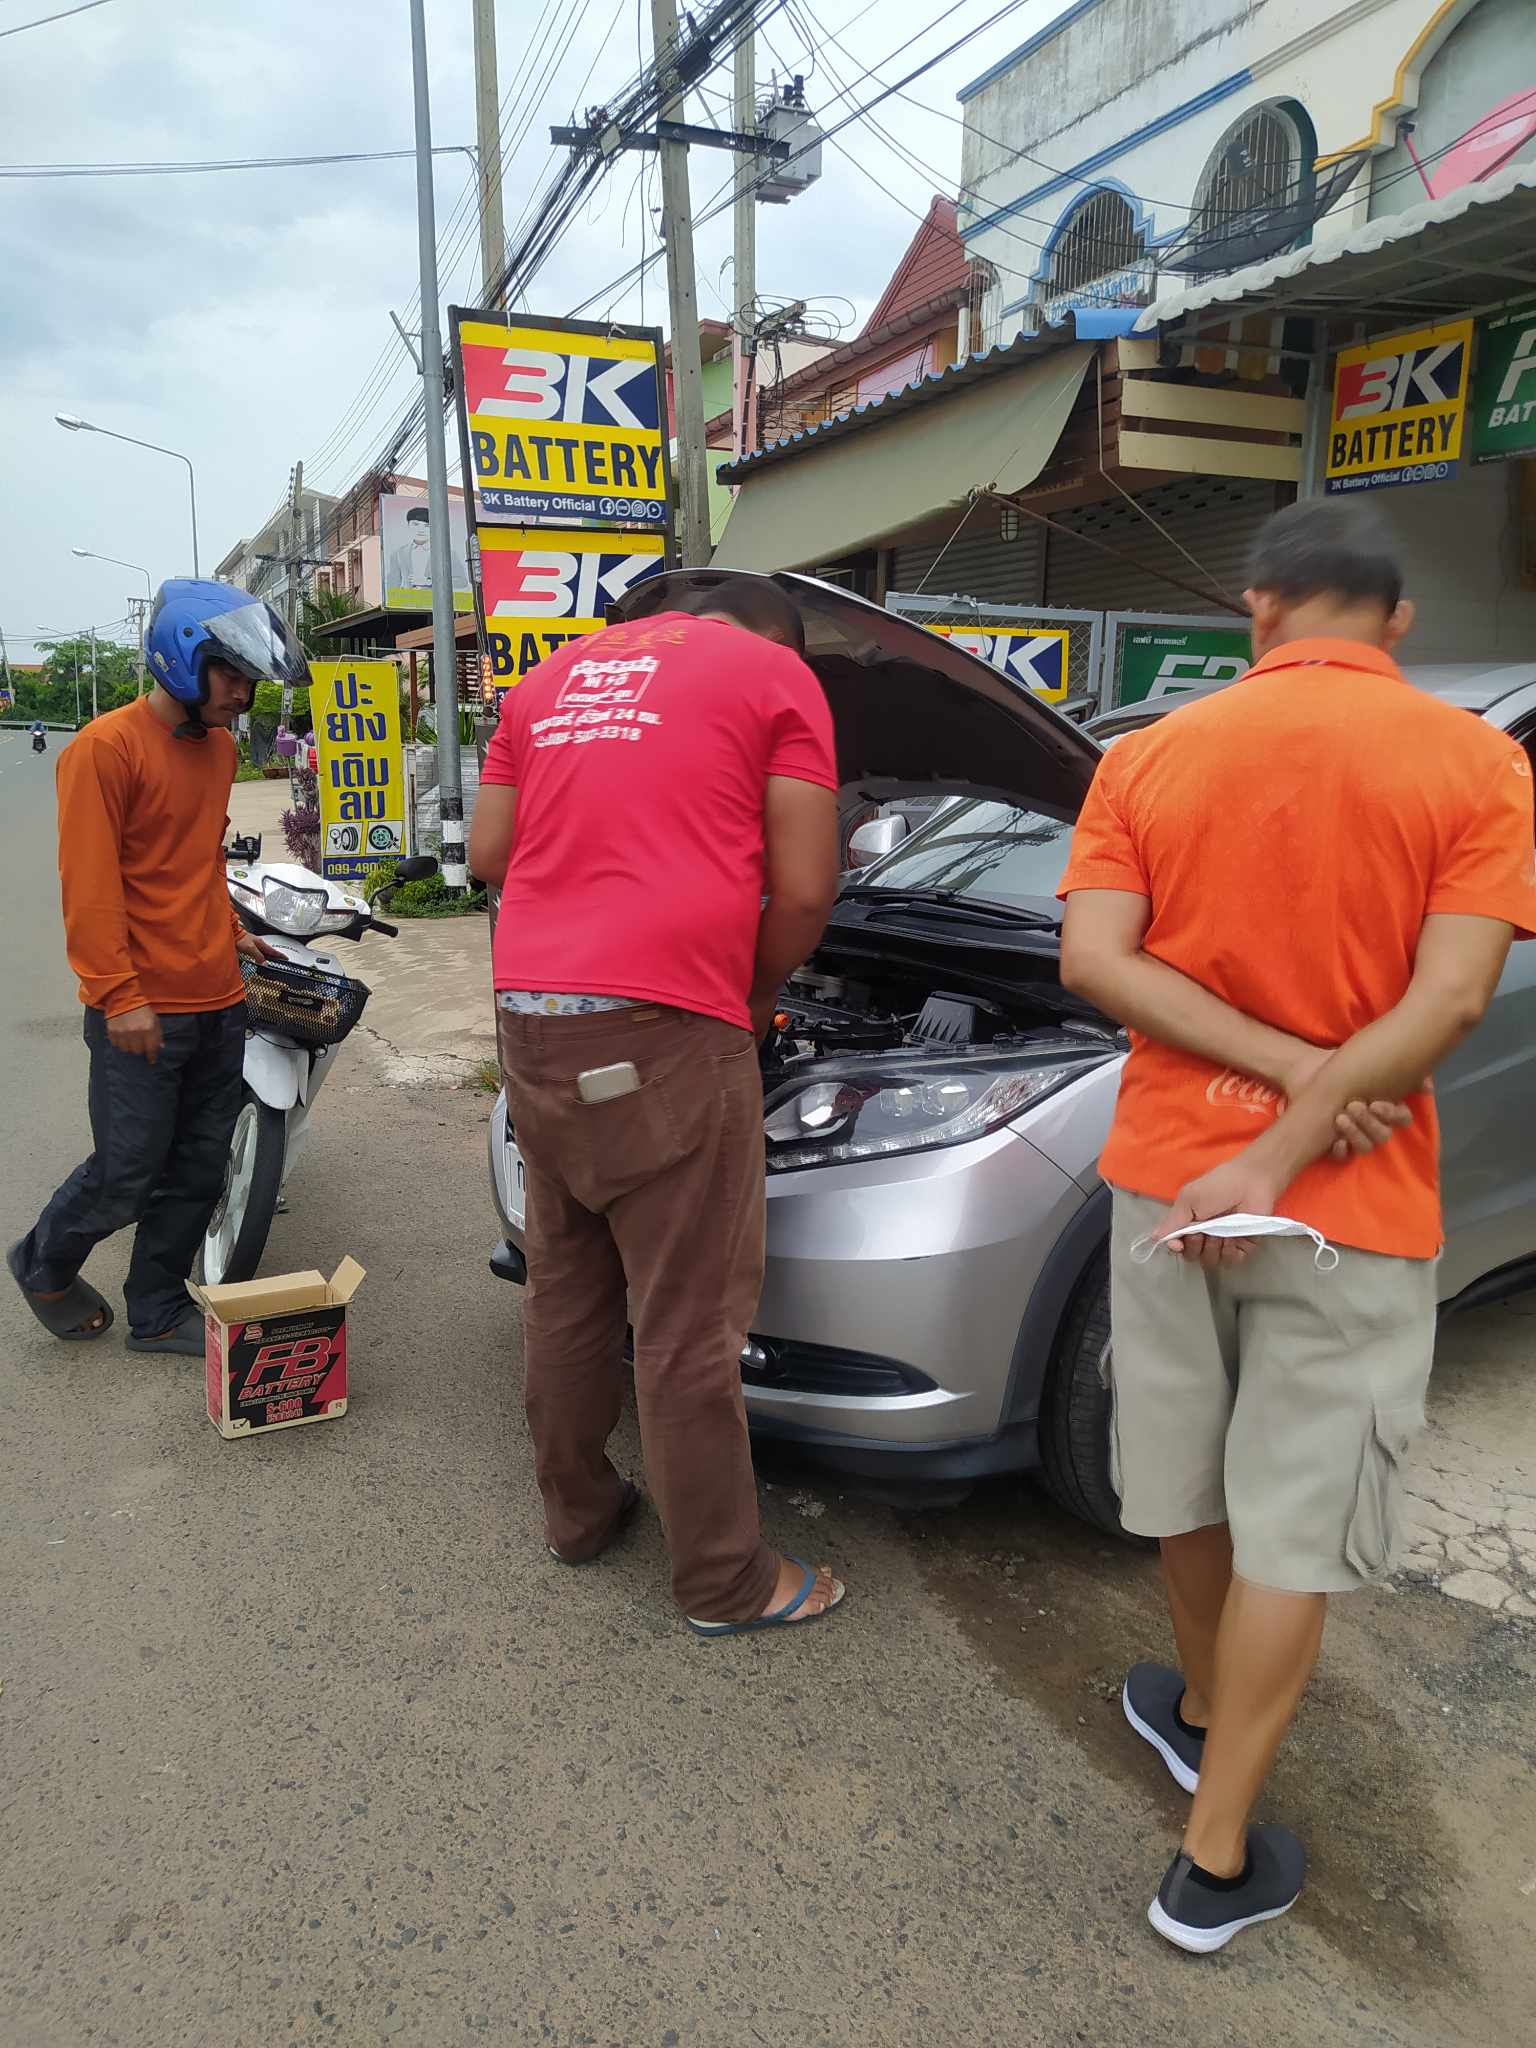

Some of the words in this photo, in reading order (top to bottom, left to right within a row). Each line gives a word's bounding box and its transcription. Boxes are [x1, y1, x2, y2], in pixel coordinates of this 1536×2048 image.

[475, 348, 656, 429] 3K
[1341, 339, 1464, 420] 3K
[1331, 412, 1457, 469] BATTERY
[471, 431, 661, 489] BATTERY
[1343, 476, 1370, 489] Battery
[1371, 471, 1400, 485] Official
[483, 492, 501, 505] 3K
[504, 493, 550, 511] Battery
[552, 497, 596, 513] Official
[492, 551, 665, 618] 3K
[490, 632, 593, 676] BAT
[334, 672, 373, 710] ปะ
[326, 712, 387, 742] ยาง
[330, 752, 390, 788] เติม
[339, 790, 386, 821] ลม
[328, 862, 380, 875] 099-480
[244, 1336, 331, 1386] FB
[237, 1372, 327, 1401] BATTERY
